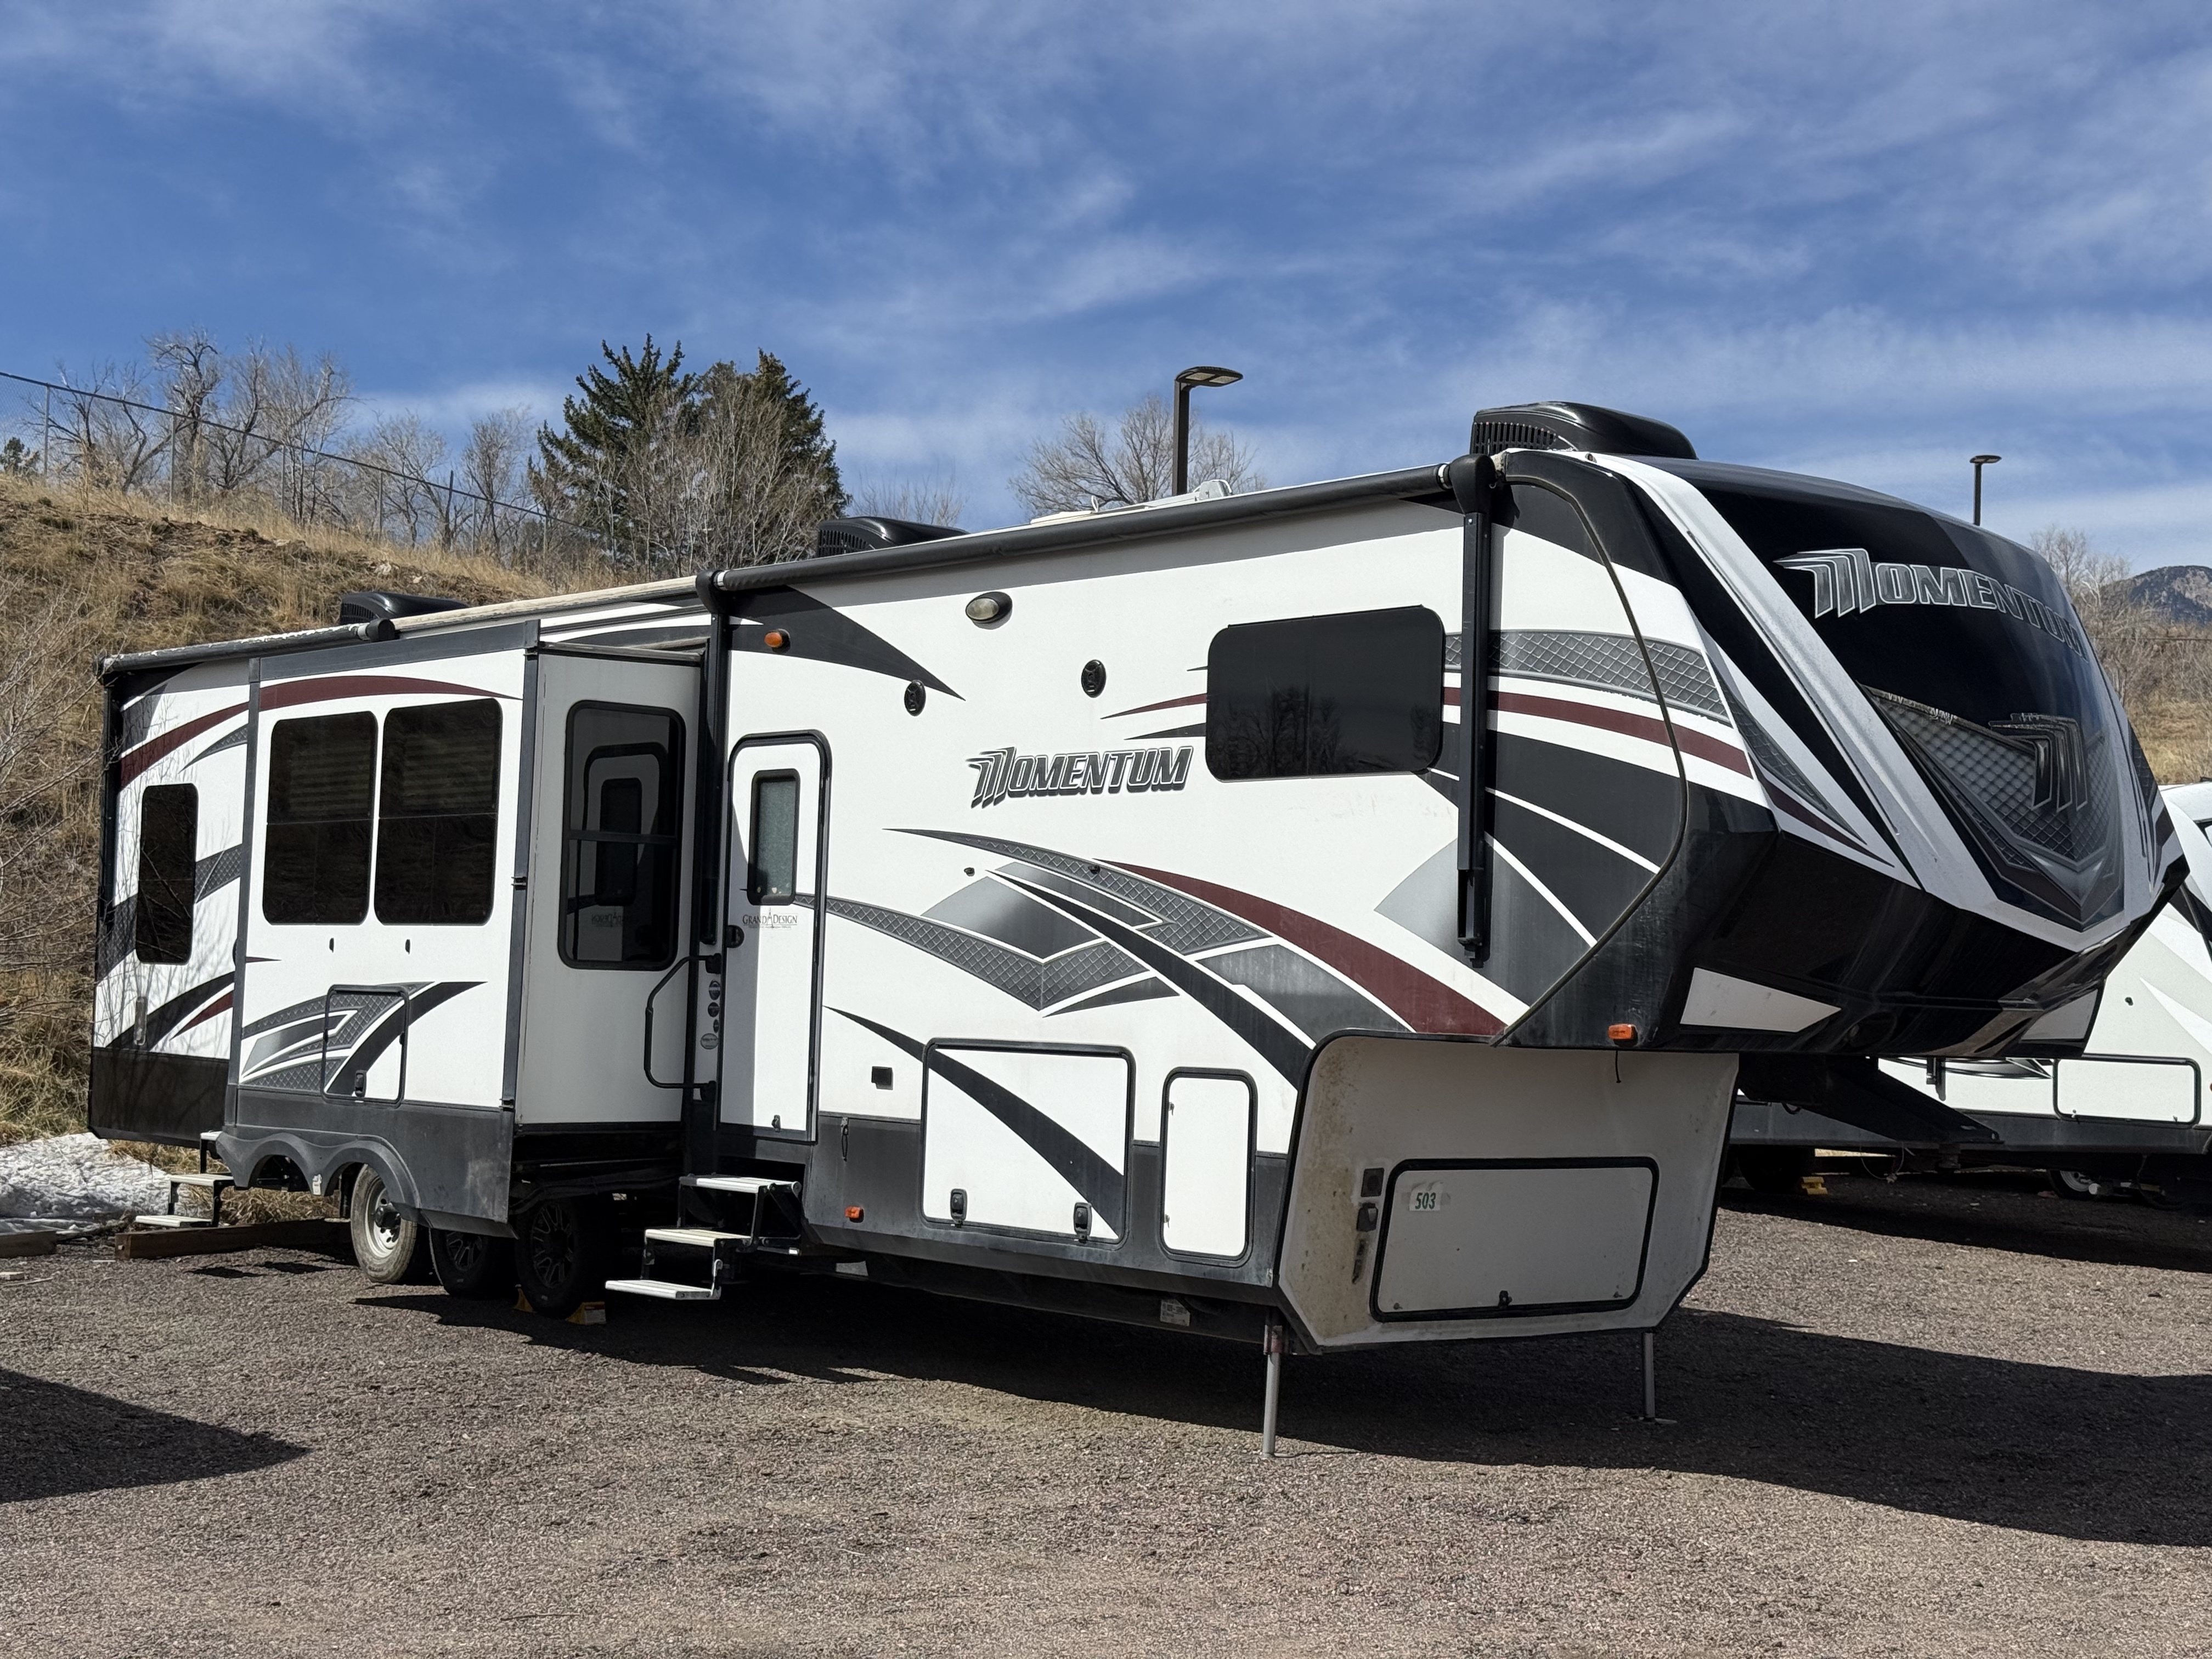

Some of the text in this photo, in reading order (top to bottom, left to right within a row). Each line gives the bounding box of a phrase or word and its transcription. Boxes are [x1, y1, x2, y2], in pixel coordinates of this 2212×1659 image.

[1773, 548, 2083, 657] MOMENTUM
[966, 746, 1194, 809] MOMENTUM
[742, 914, 798, 924] GRAND DESIGN
[1415, 1192, 1436, 1210] 503
